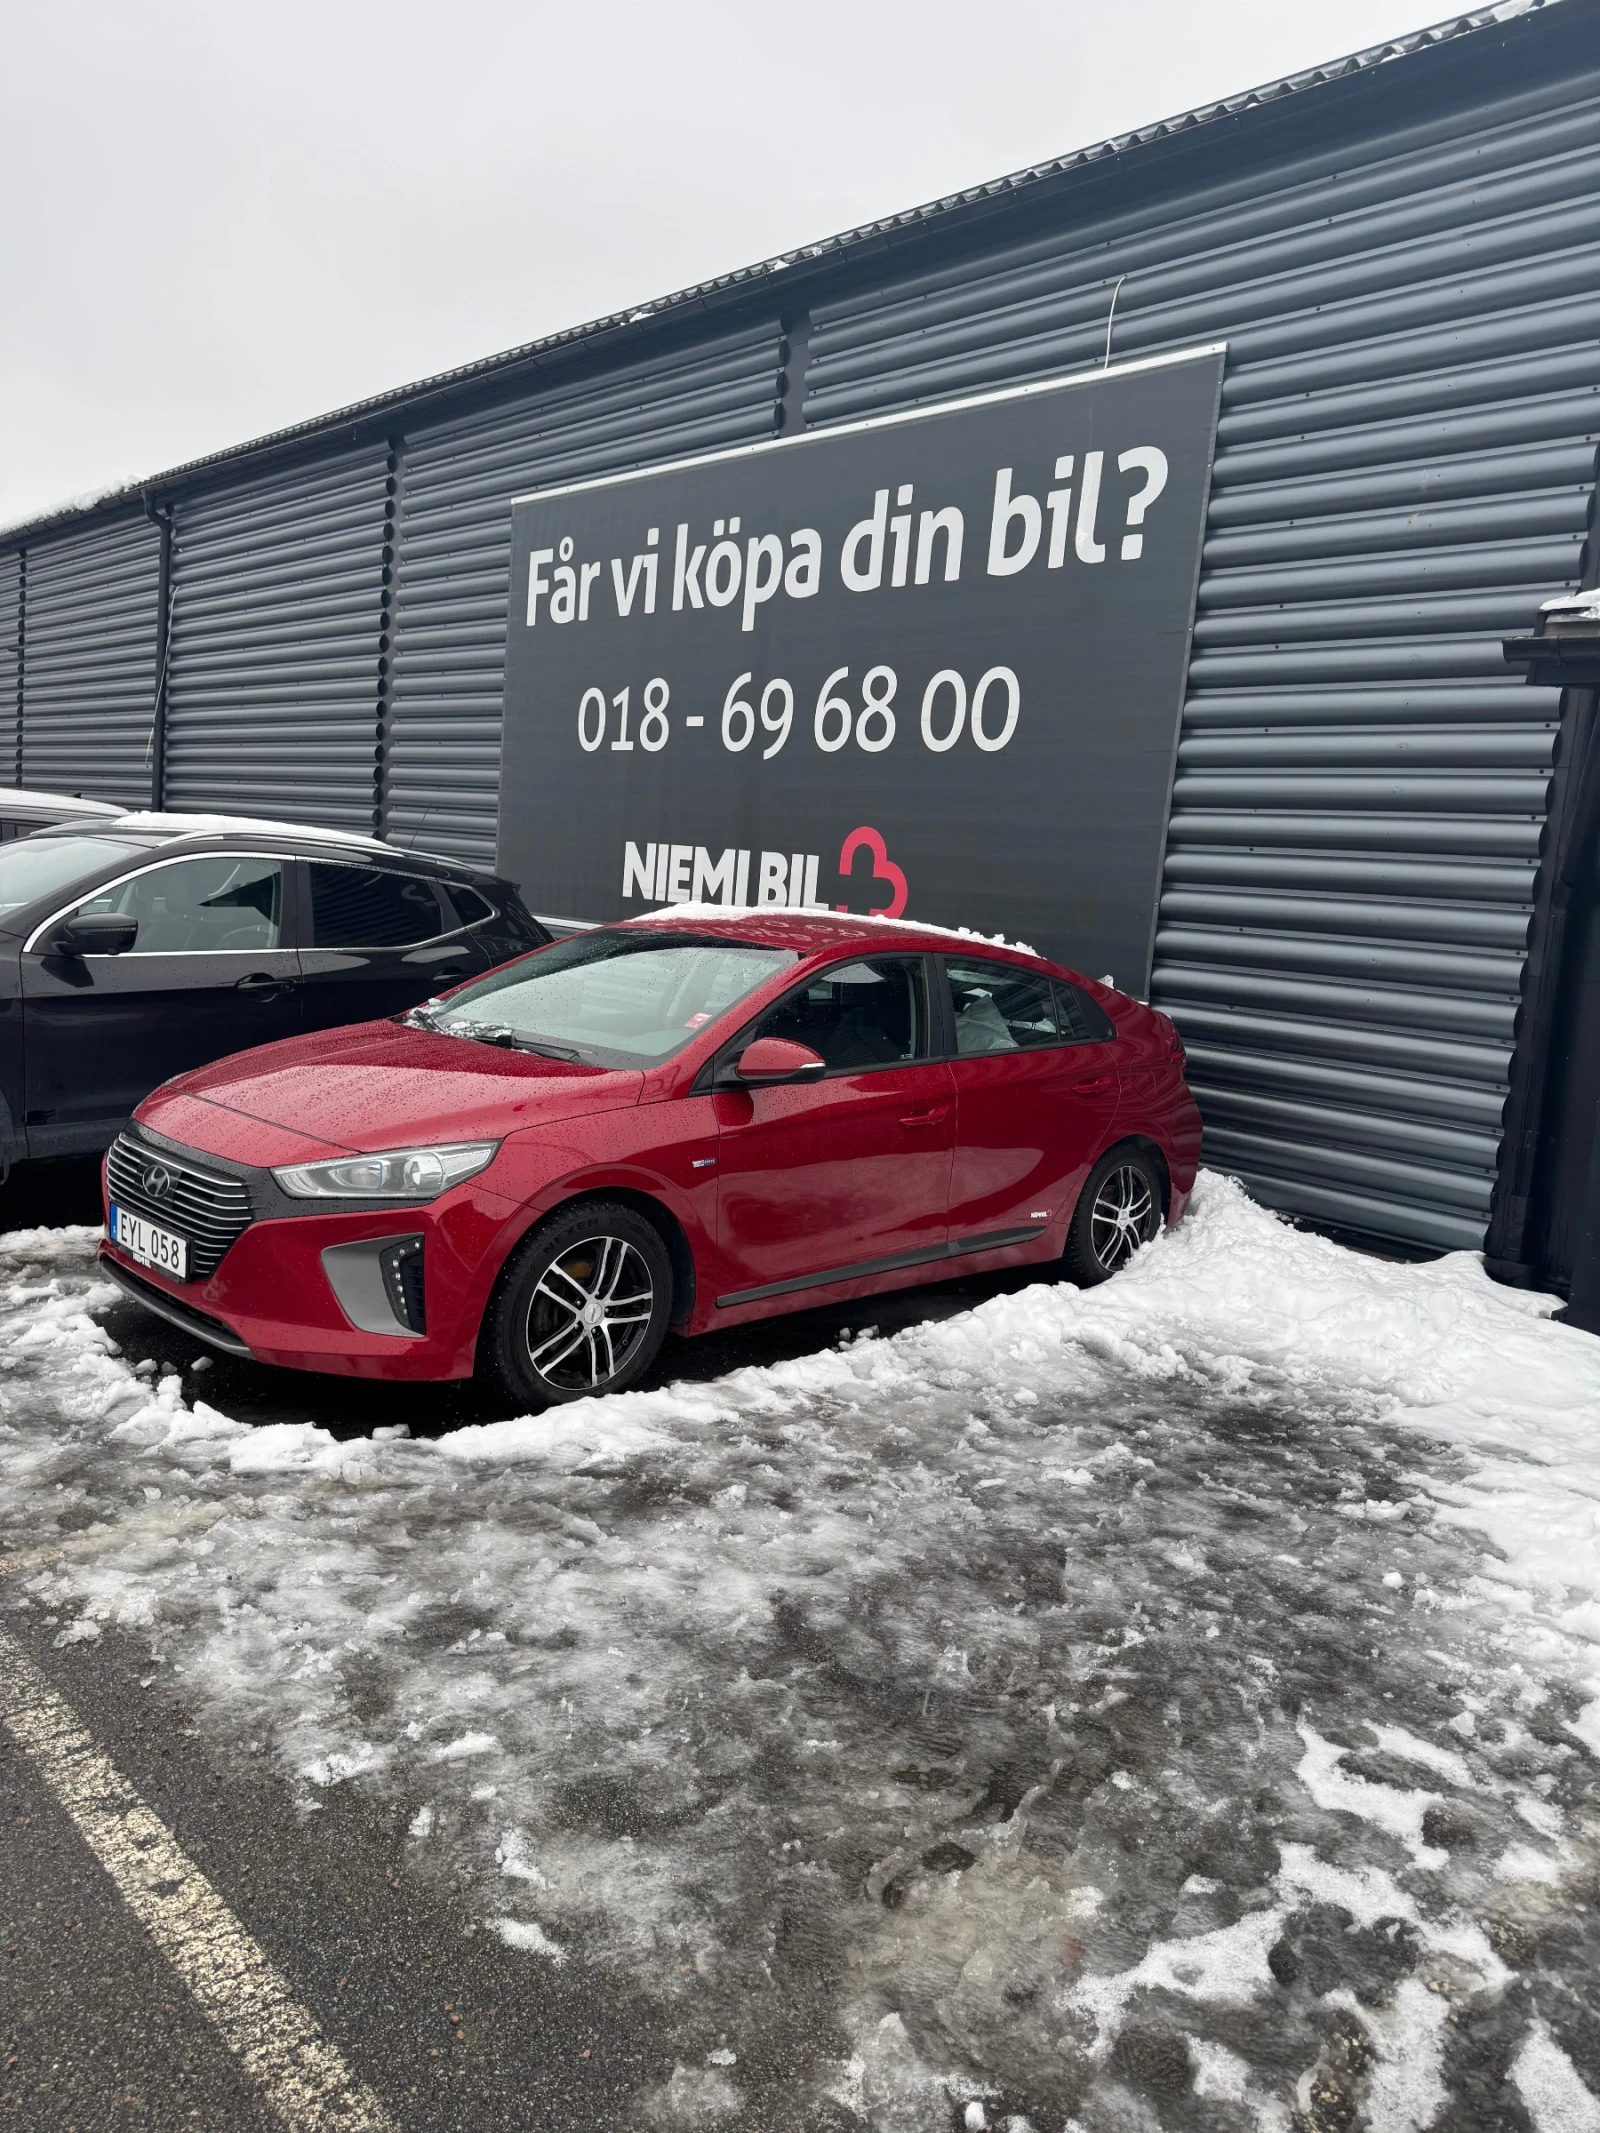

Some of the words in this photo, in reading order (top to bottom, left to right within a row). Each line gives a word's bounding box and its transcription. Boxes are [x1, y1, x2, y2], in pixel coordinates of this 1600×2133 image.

[526, 536, 600, 626] Får
[611, 527, 659, 616] vi
[671, 516, 822, 631] köpa
[840, 483, 964, 592] din
[986, 446, 1169, 576] bil?
[577, 678, 670, 752] 018
[721, 672, 795, 760] 69
[813, 666, 898, 752] 68
[920, 667, 1021, 752] 00
[622, 841, 751, 908] NIEMI
[758, 851, 830, 911] BIL
[121, 1213, 145, 1253] EYL
[151, 1230, 179, 1269] 058
